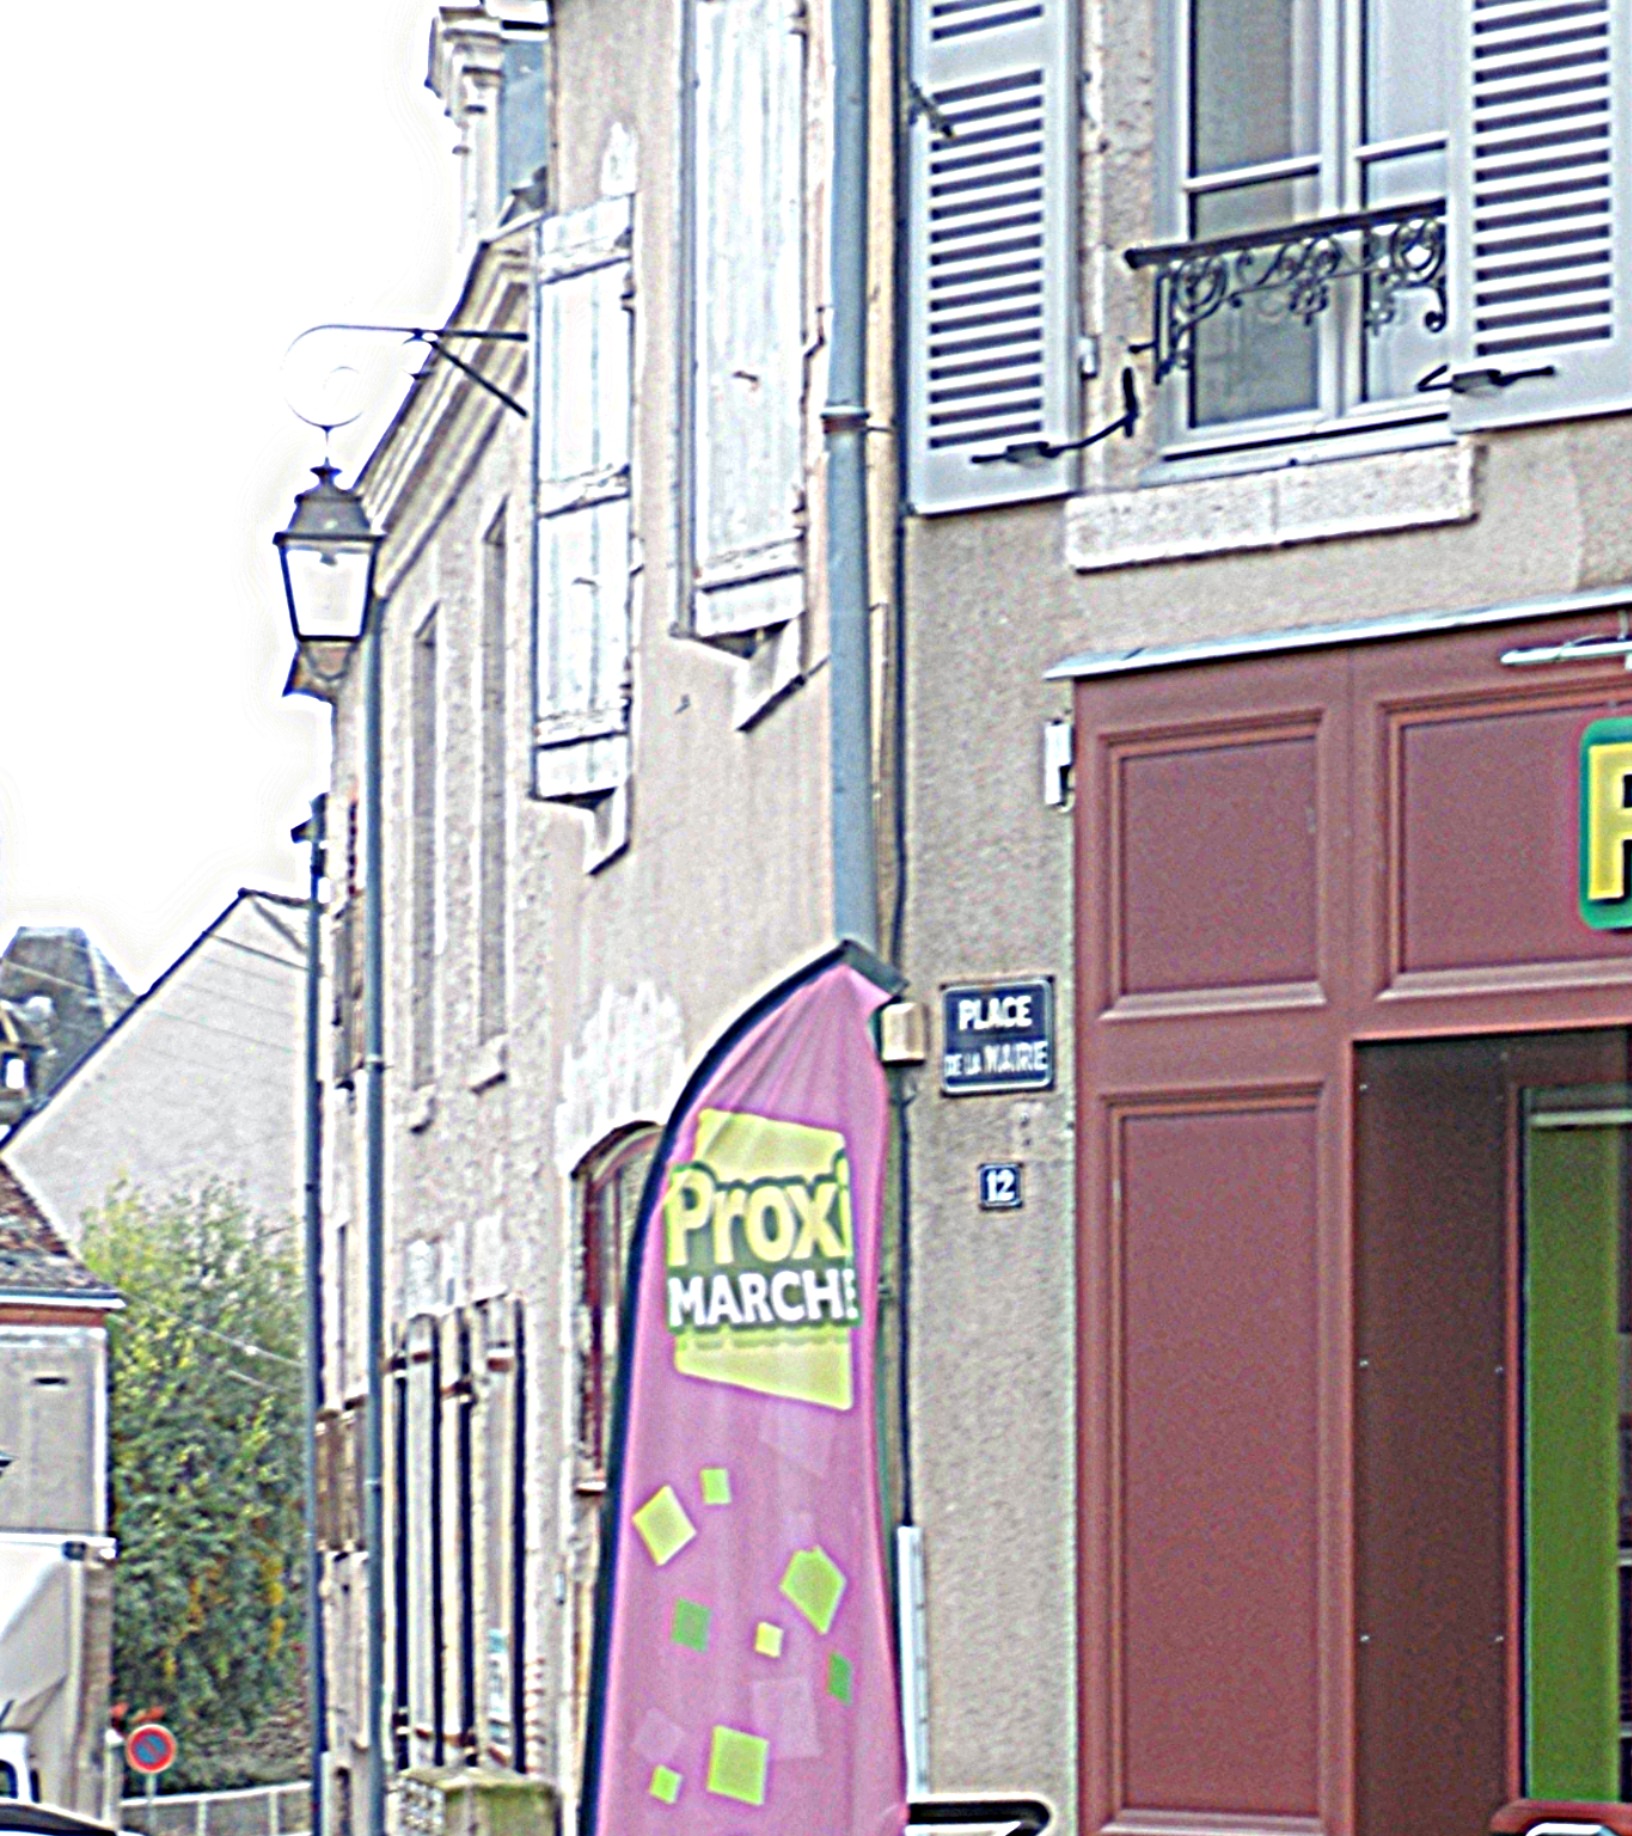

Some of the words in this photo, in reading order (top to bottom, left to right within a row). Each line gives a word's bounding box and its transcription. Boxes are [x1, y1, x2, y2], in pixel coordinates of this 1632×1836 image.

[958, 994, 1033, 1032] PLACE
[943, 1053, 963, 1078] DE
[963, 1052, 982, 1076] LA
[985, 1168, 1016, 1202] 12
